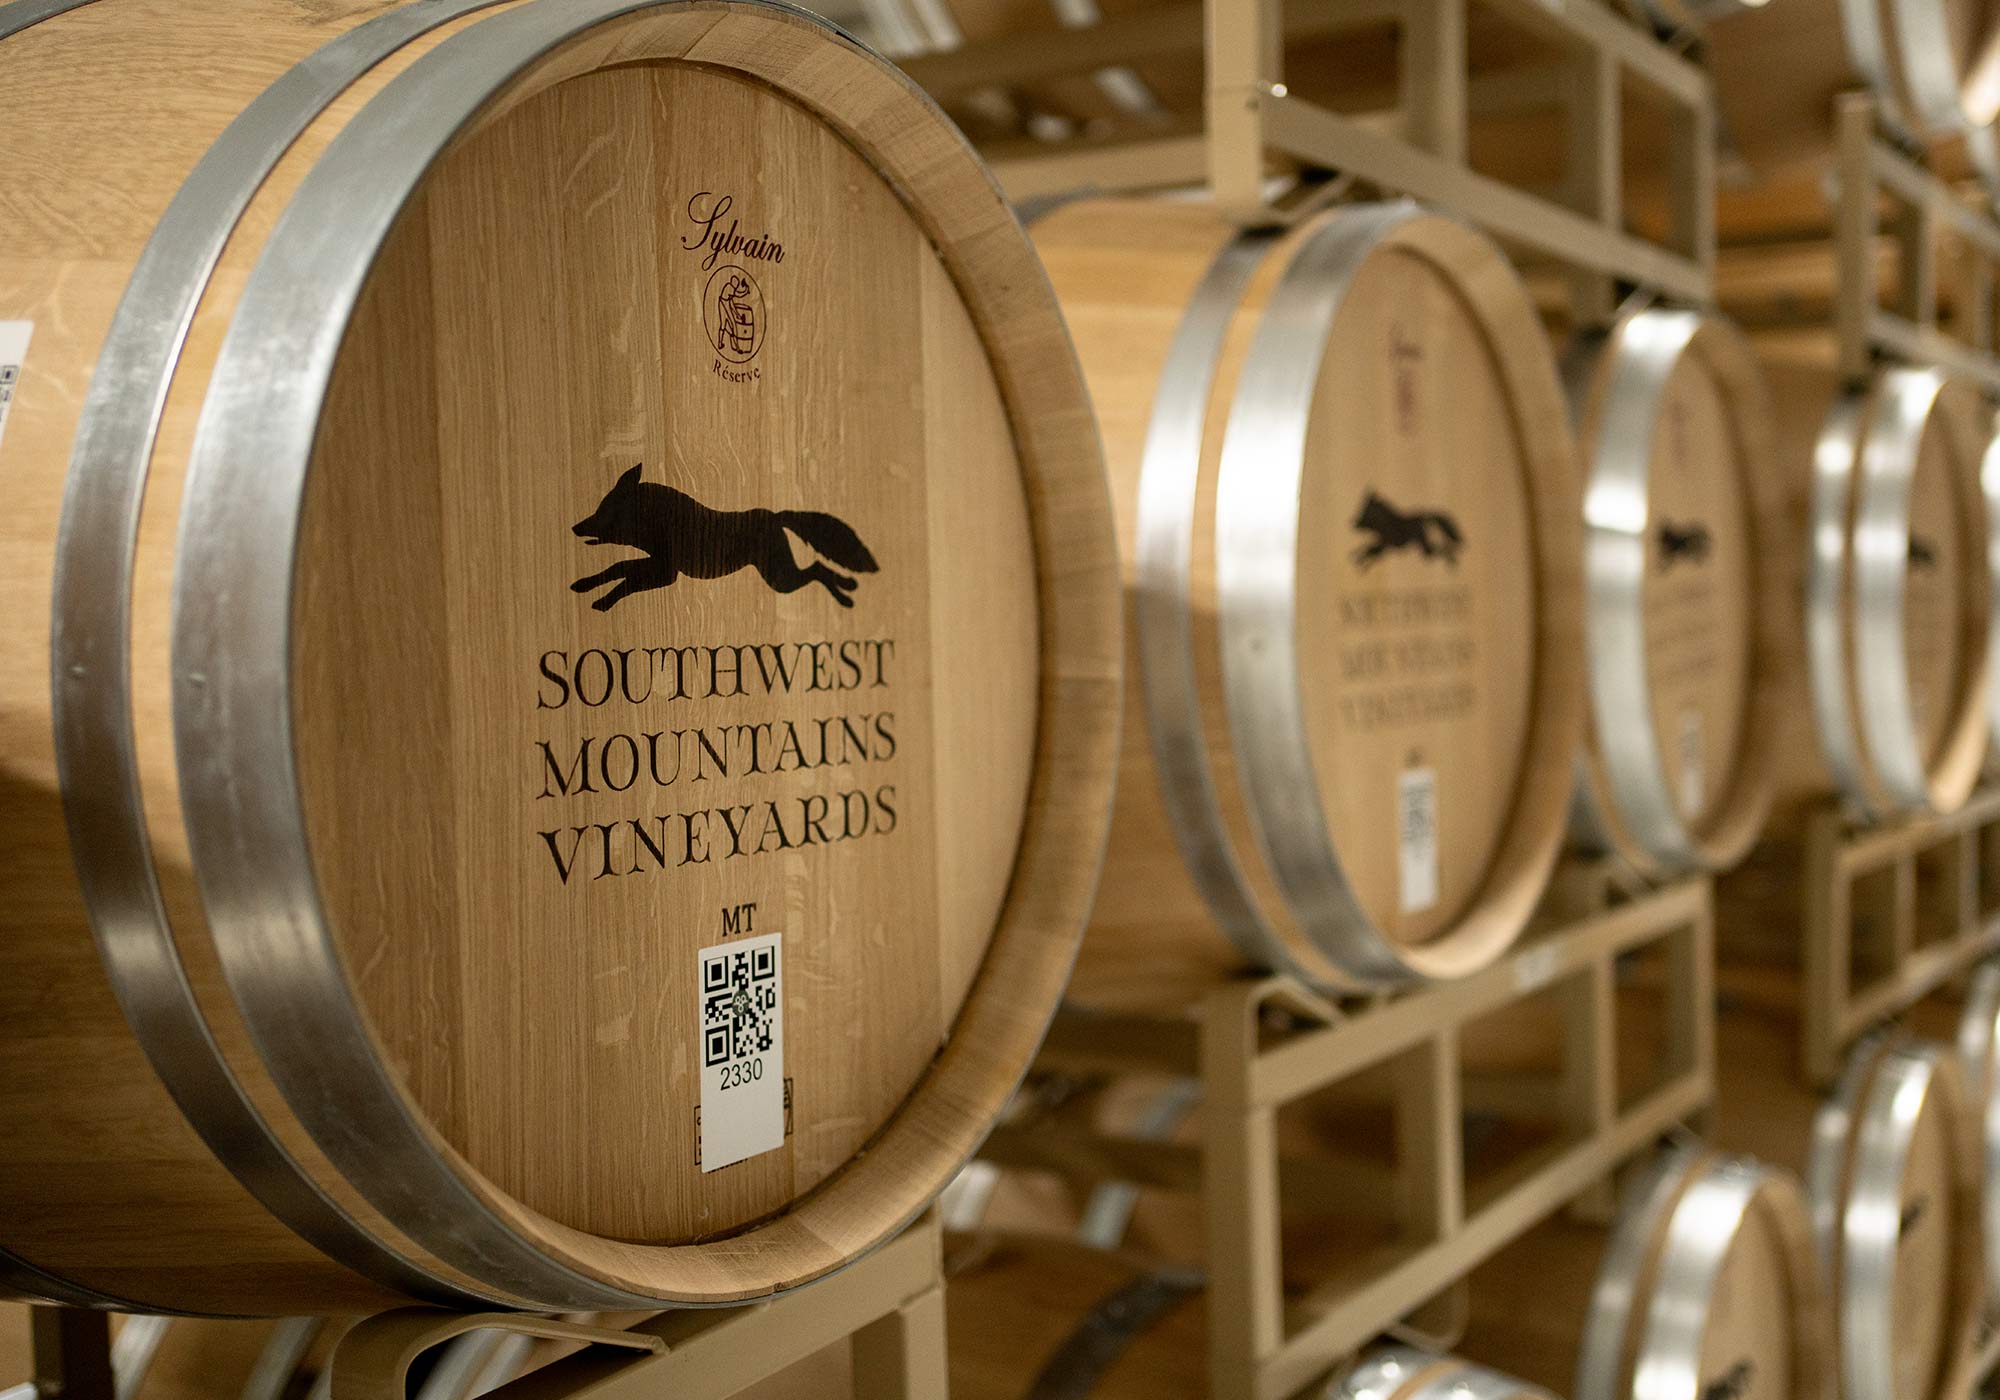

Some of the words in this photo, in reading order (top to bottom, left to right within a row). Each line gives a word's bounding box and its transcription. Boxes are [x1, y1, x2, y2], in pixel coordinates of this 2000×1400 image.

[681, 191, 785, 271] Sylvain
[712, 359, 760, 383] Réserve
[536, 639, 895, 710] SOUTHWEST
[535, 711, 897, 800] MOUNTAINS
[537, 785, 897, 886] VINEYARDS
[721, 903, 757, 937] MT
[720, 1058, 762, 1090] 2330
